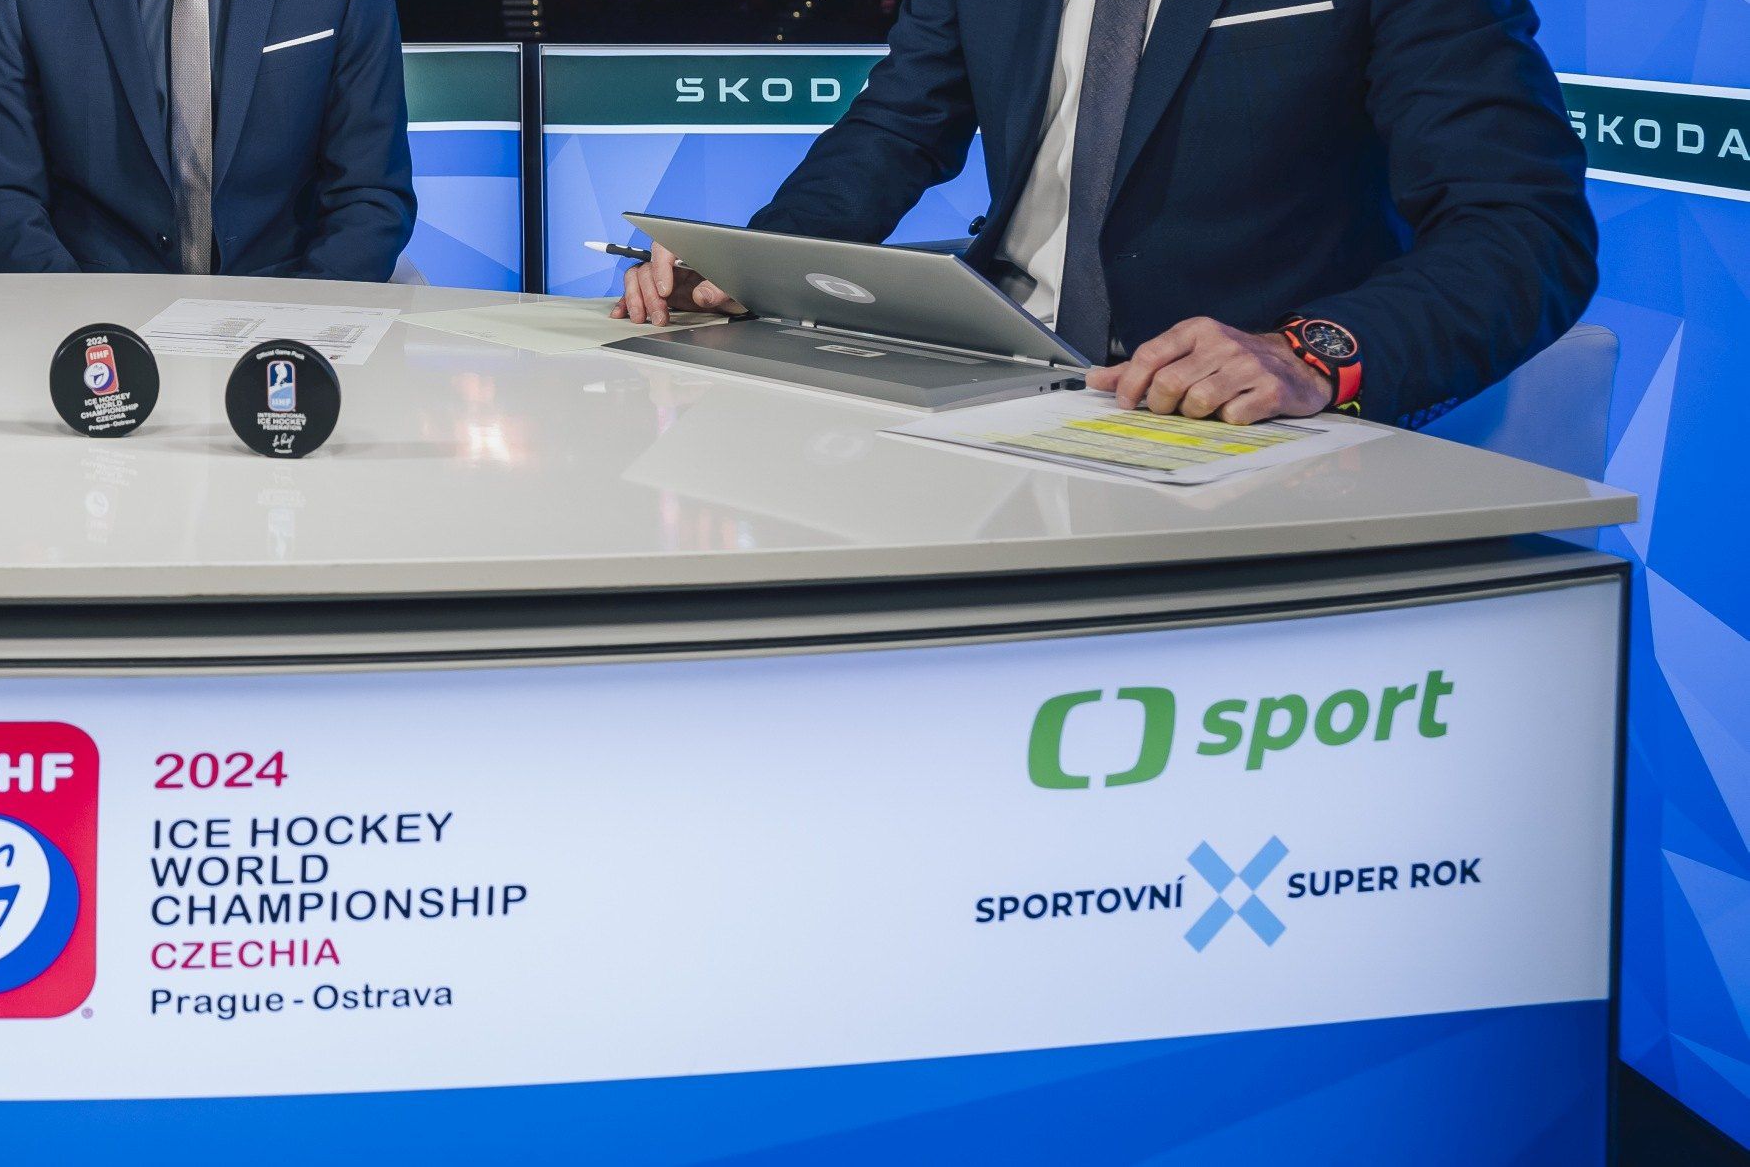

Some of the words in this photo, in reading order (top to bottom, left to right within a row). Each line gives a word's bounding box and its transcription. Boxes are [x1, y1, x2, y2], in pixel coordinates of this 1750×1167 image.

[675, 77, 868, 103] SKOD
[85, 335, 109, 347] 2024
[1196, 670, 1454, 771] sport
[153, 750, 289, 790] 2024
[152, 818, 232, 851] ICE
[250, 811, 454, 849] HOCKEY
[150, 854, 330, 889] WORLD
[975, 875, 1187, 923] SPORTOVNÍ
[1287, 865, 1399, 899] SUPER
[1410, 857, 1482, 889] ROK
[151, 884, 528, 927] CHAMPIONSHIP
[150, 938, 341, 971] CZECHIA
